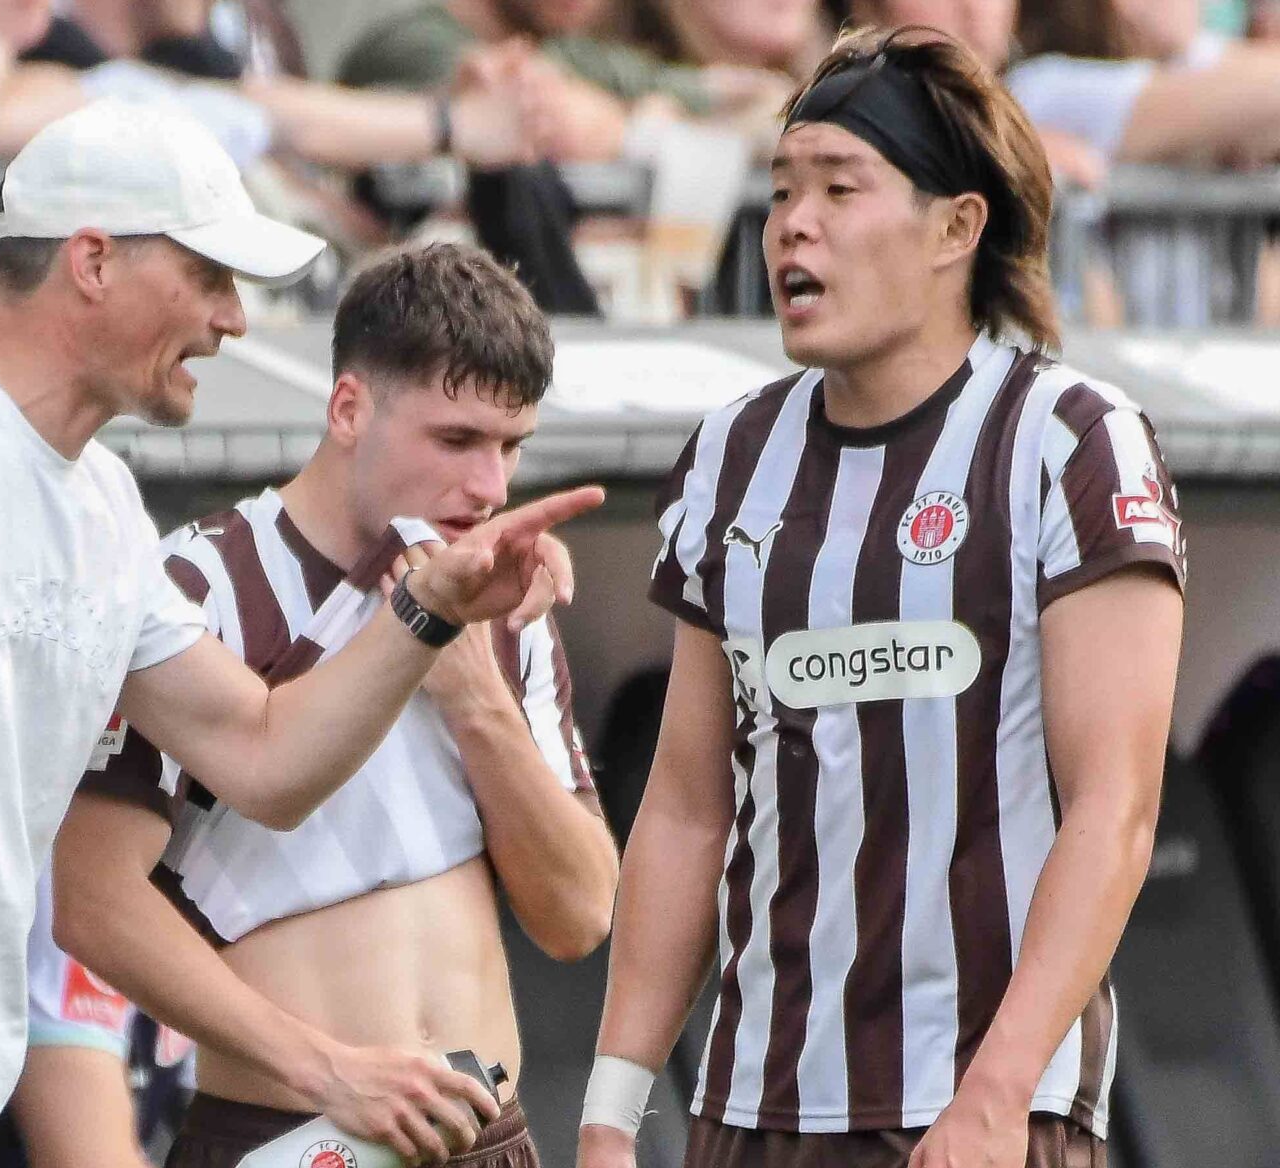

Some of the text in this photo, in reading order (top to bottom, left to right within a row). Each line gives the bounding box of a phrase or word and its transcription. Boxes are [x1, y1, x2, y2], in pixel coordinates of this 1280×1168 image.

[901, 513, 914, 528] FC
[937, 494, 966, 523] PAULI
[913, 549, 942, 561] 1910
[788, 638, 954, 688] congstar
